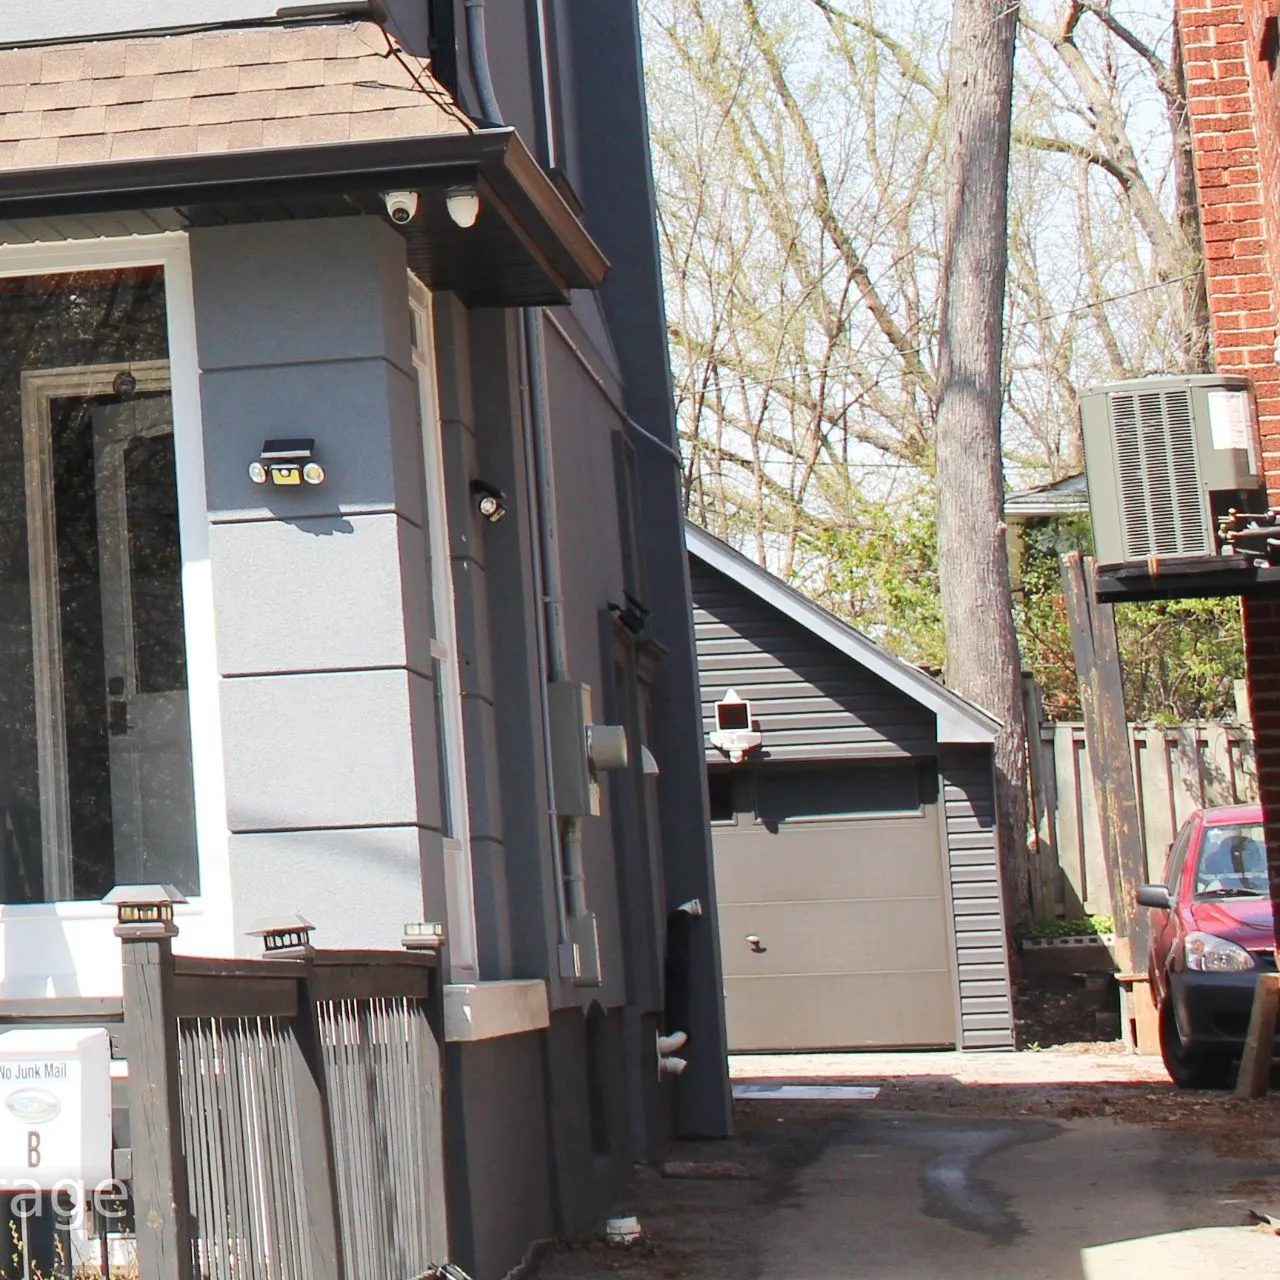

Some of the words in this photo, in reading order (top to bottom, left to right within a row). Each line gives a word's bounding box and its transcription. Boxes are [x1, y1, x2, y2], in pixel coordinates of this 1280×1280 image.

[15, 1063, 41, 1080] Junk
[44, 1062, 67, 1079] Mail
[27, 1130, 41, 1168] B
